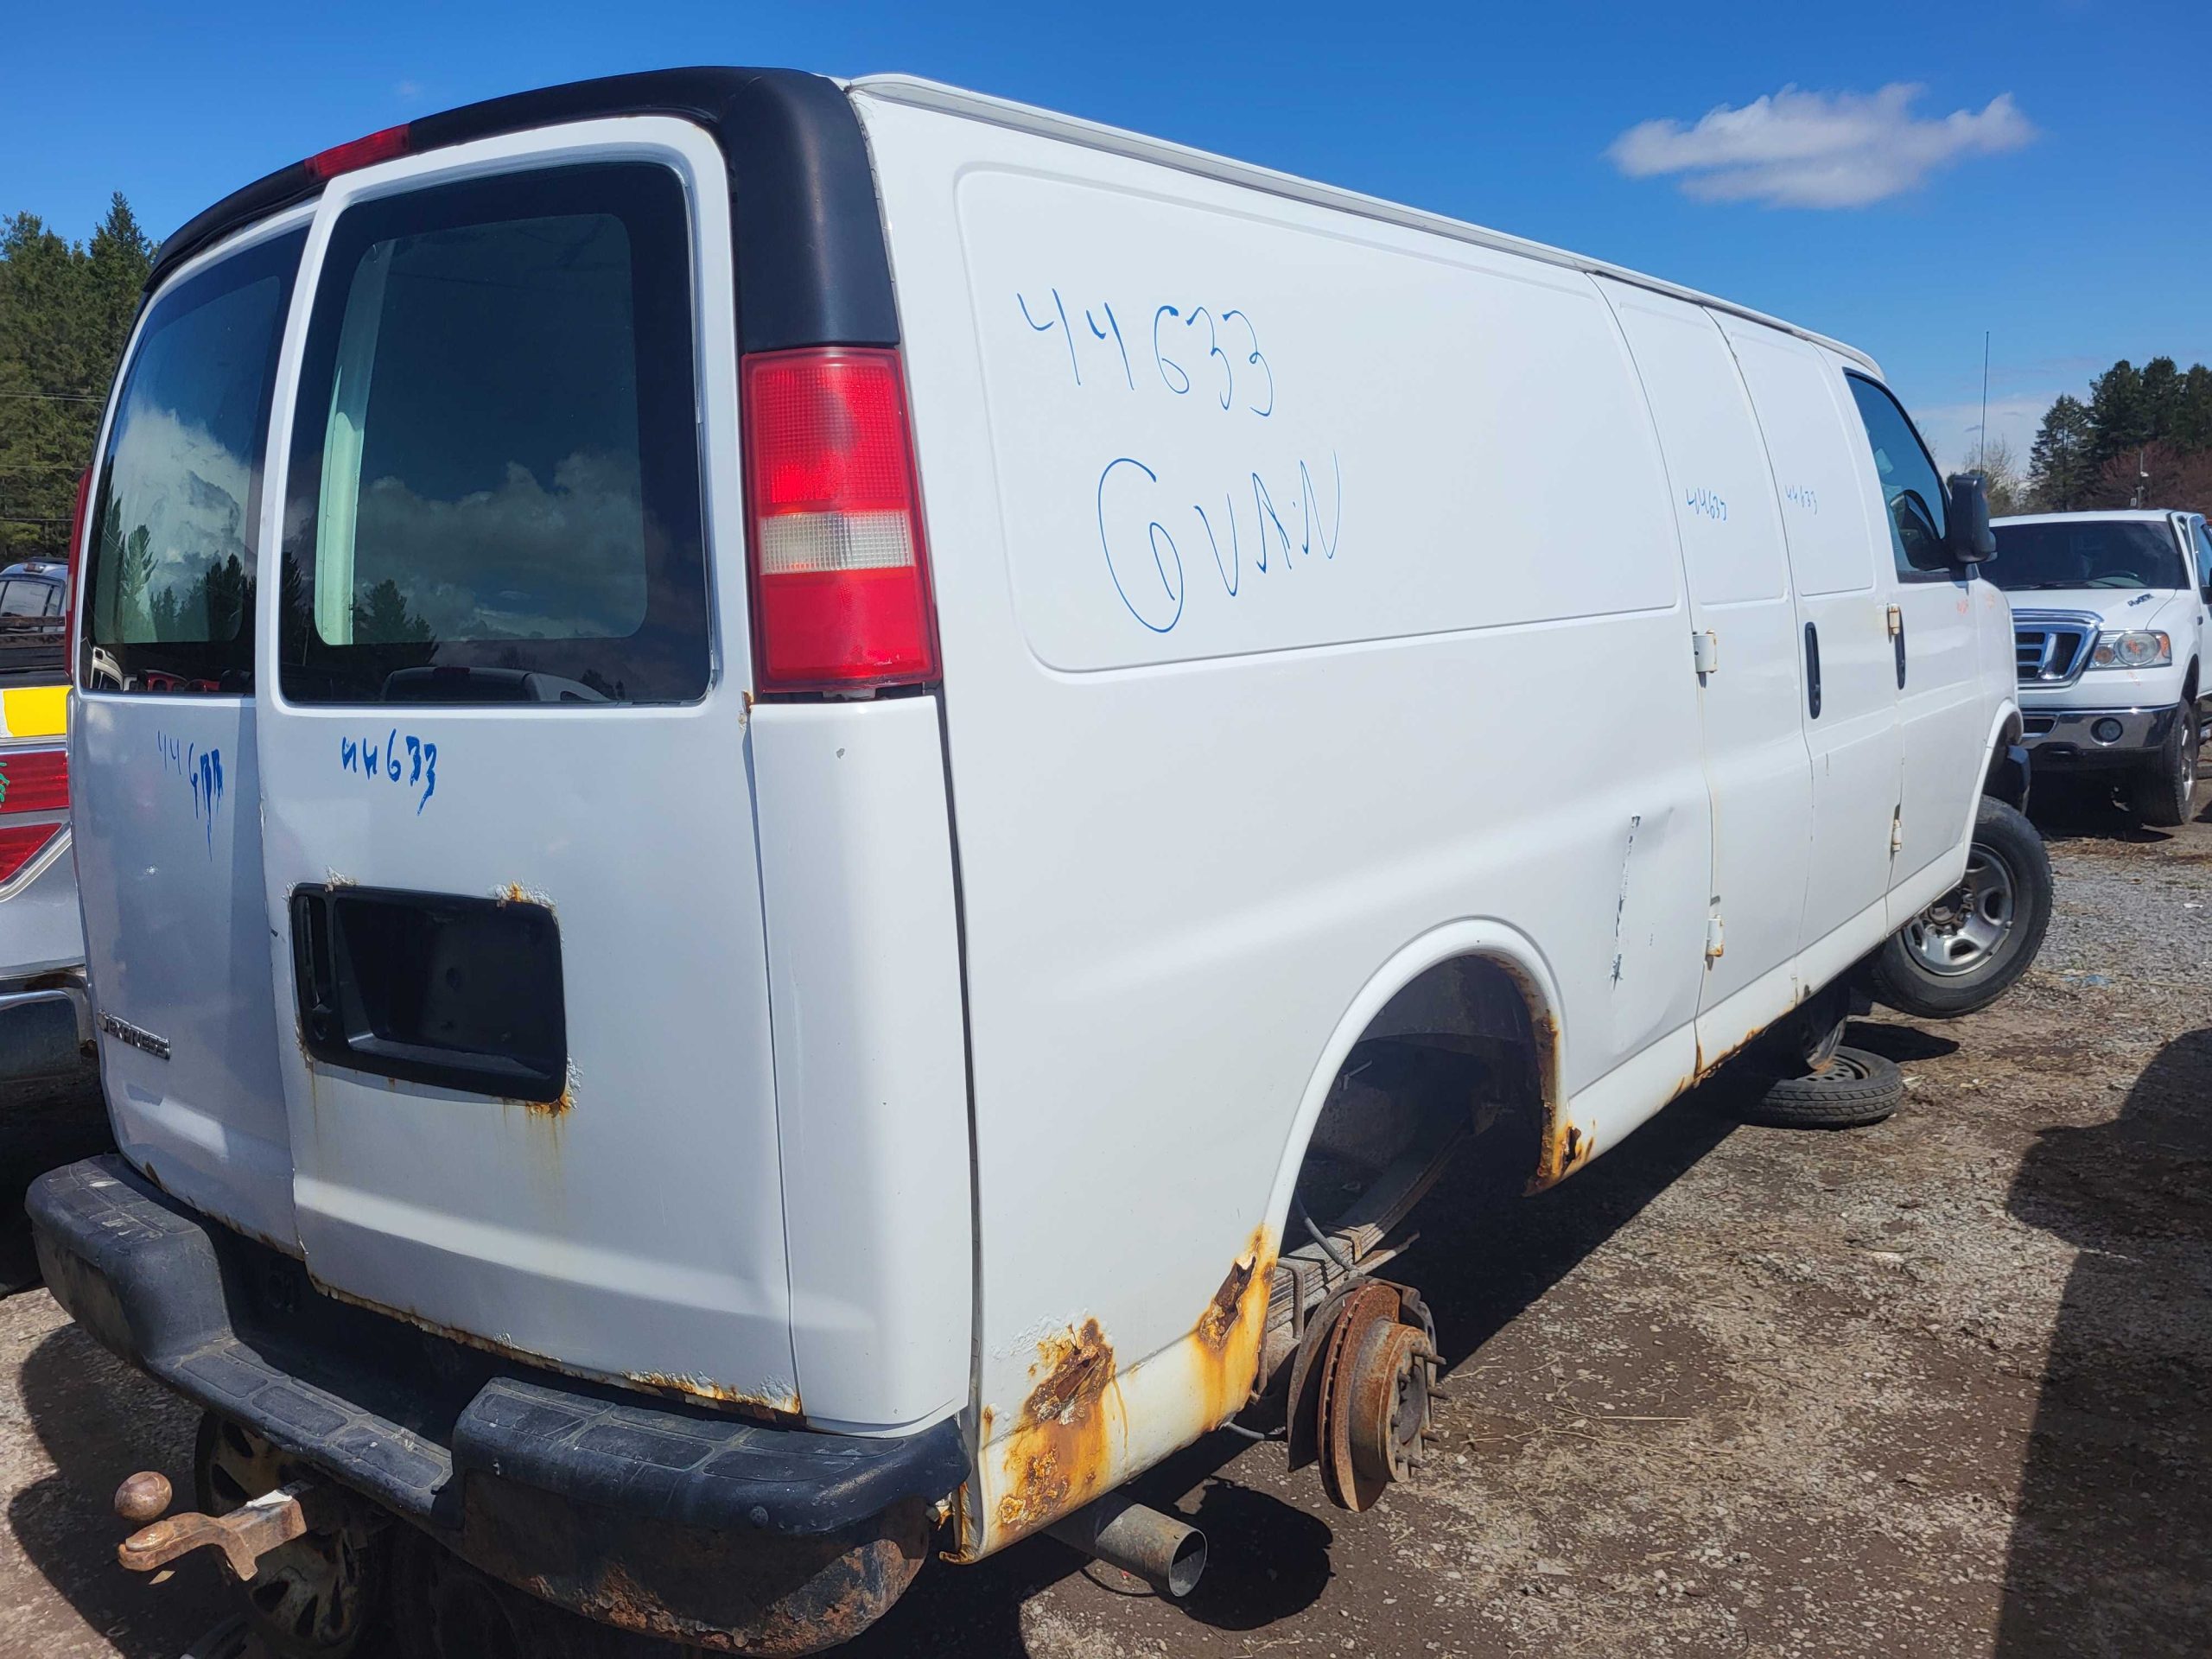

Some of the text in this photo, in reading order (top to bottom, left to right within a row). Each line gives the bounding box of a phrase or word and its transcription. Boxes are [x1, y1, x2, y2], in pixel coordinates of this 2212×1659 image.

[1016, 288, 1274, 418] 44633
[340, 728, 438, 816] 44633
[103, 1011, 171, 1060] EXPRESS
